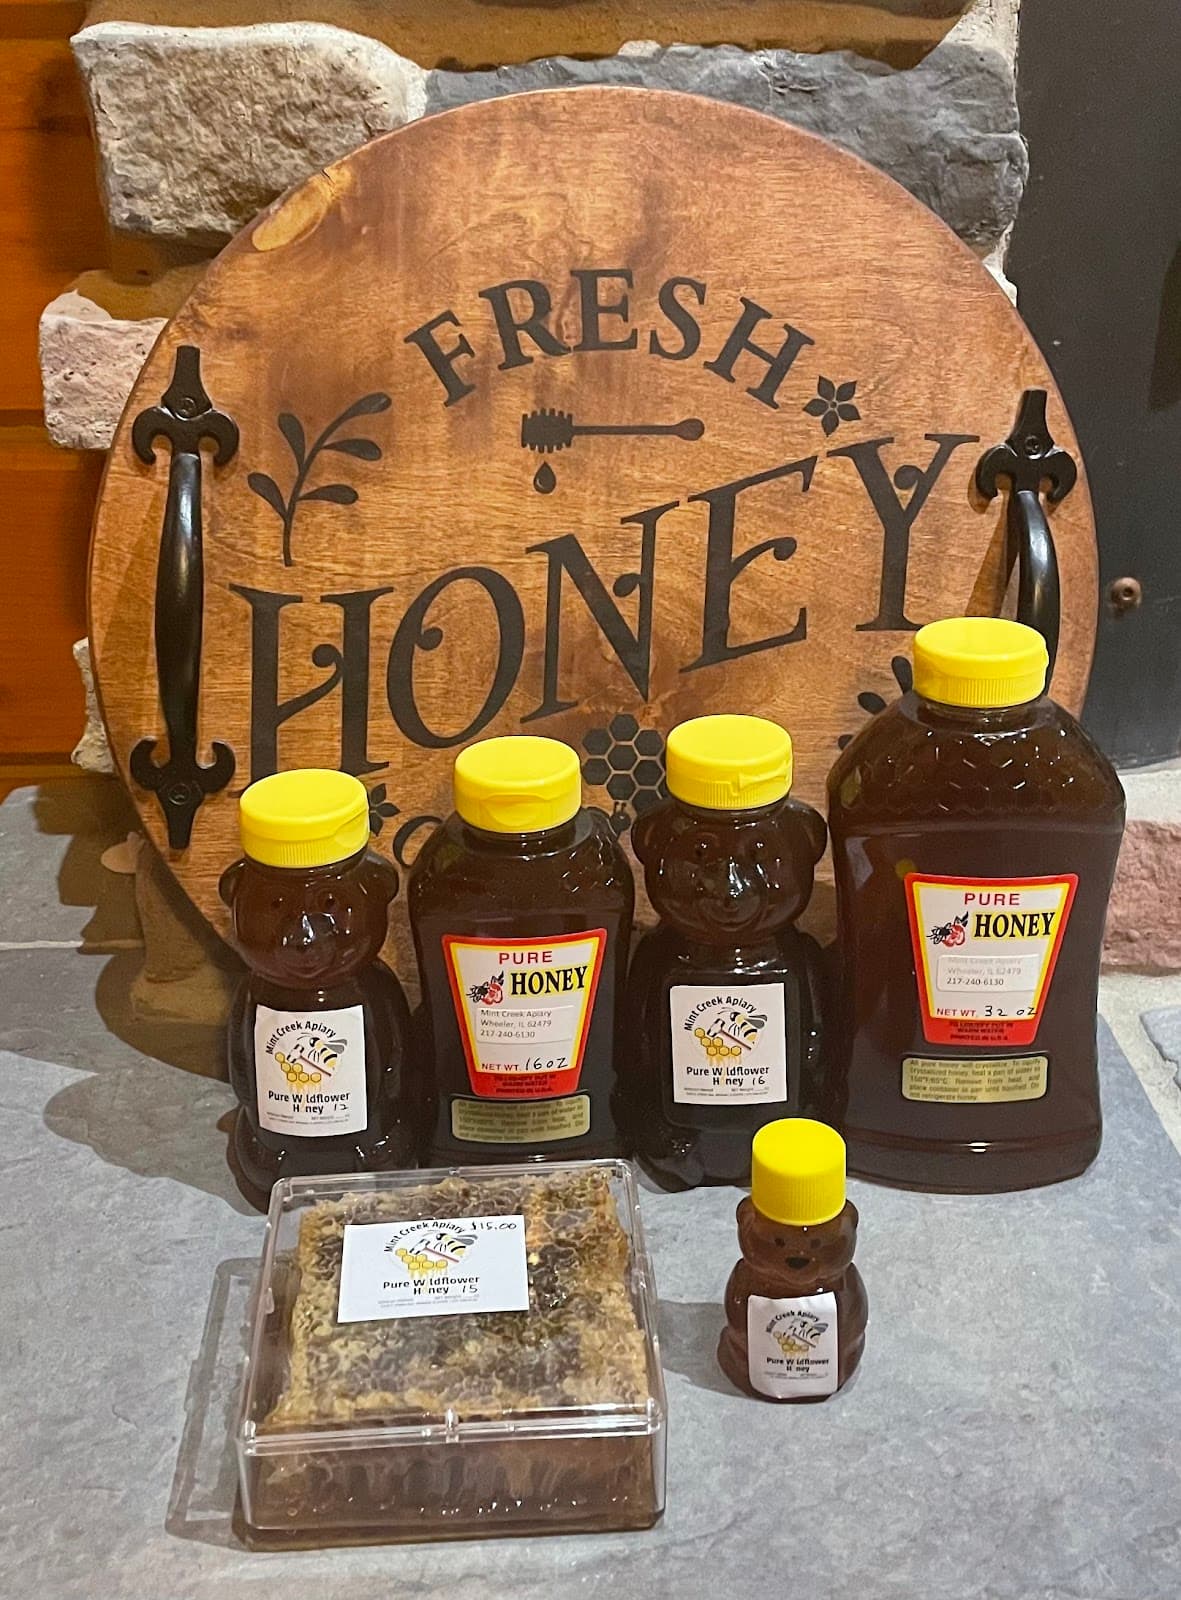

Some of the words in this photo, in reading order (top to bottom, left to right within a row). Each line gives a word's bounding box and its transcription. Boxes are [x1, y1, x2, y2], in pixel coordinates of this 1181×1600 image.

[404, 268, 815, 409] FRESH
[229, 433, 980, 781] HONEY
[964, 893, 1021, 906] PURE
[974, 911, 1056, 938] HONEY
[499, 951, 553, 965] PURE
[510, 965, 588, 996] HONEY
[946, 978, 1004, 986] 217-240-6130
[502, 1010, 524, 1018] Creek
[684, 1010, 699, 1031] Mint
[696, 996, 723, 1012] Creek
[725, 995, 757, 1014] Apiary
[936, 1007, 959, 1016] NET
[984, 1005, 1008, 1017] 32
[527, 1020, 552, 1028] 62479
[265, 1034, 280, 1055] Mint
[276, 1020, 303, 1037] Creek
[304, 1020, 337, 1038] Apiary
[480, 1029, 535, 1038] 217-240-6130
[481, 1063, 503, 1071] NET
[686, 1066, 709, 1076] Pure
[712, 1066, 770, 1076] Wldflower
[713, 1077, 744, 1087] Hney
[268, 1090, 289, 1102] Pure
[292, 1092, 350, 1104] Wldflower
[293, 1103, 324, 1115] Hney
[470, 1221, 518, 1231] $15.00
[384, 1236, 401, 1252] Mint
[399, 1222, 429, 1236] Creek
[432, 1221, 467, 1234] Apiary
[383, 1281, 410, 1289] Pure
[413, 1276, 480, 1287] Wldflower
[413, 1286, 449, 1295] Hney
[462, 1284, 478, 1294] 15
